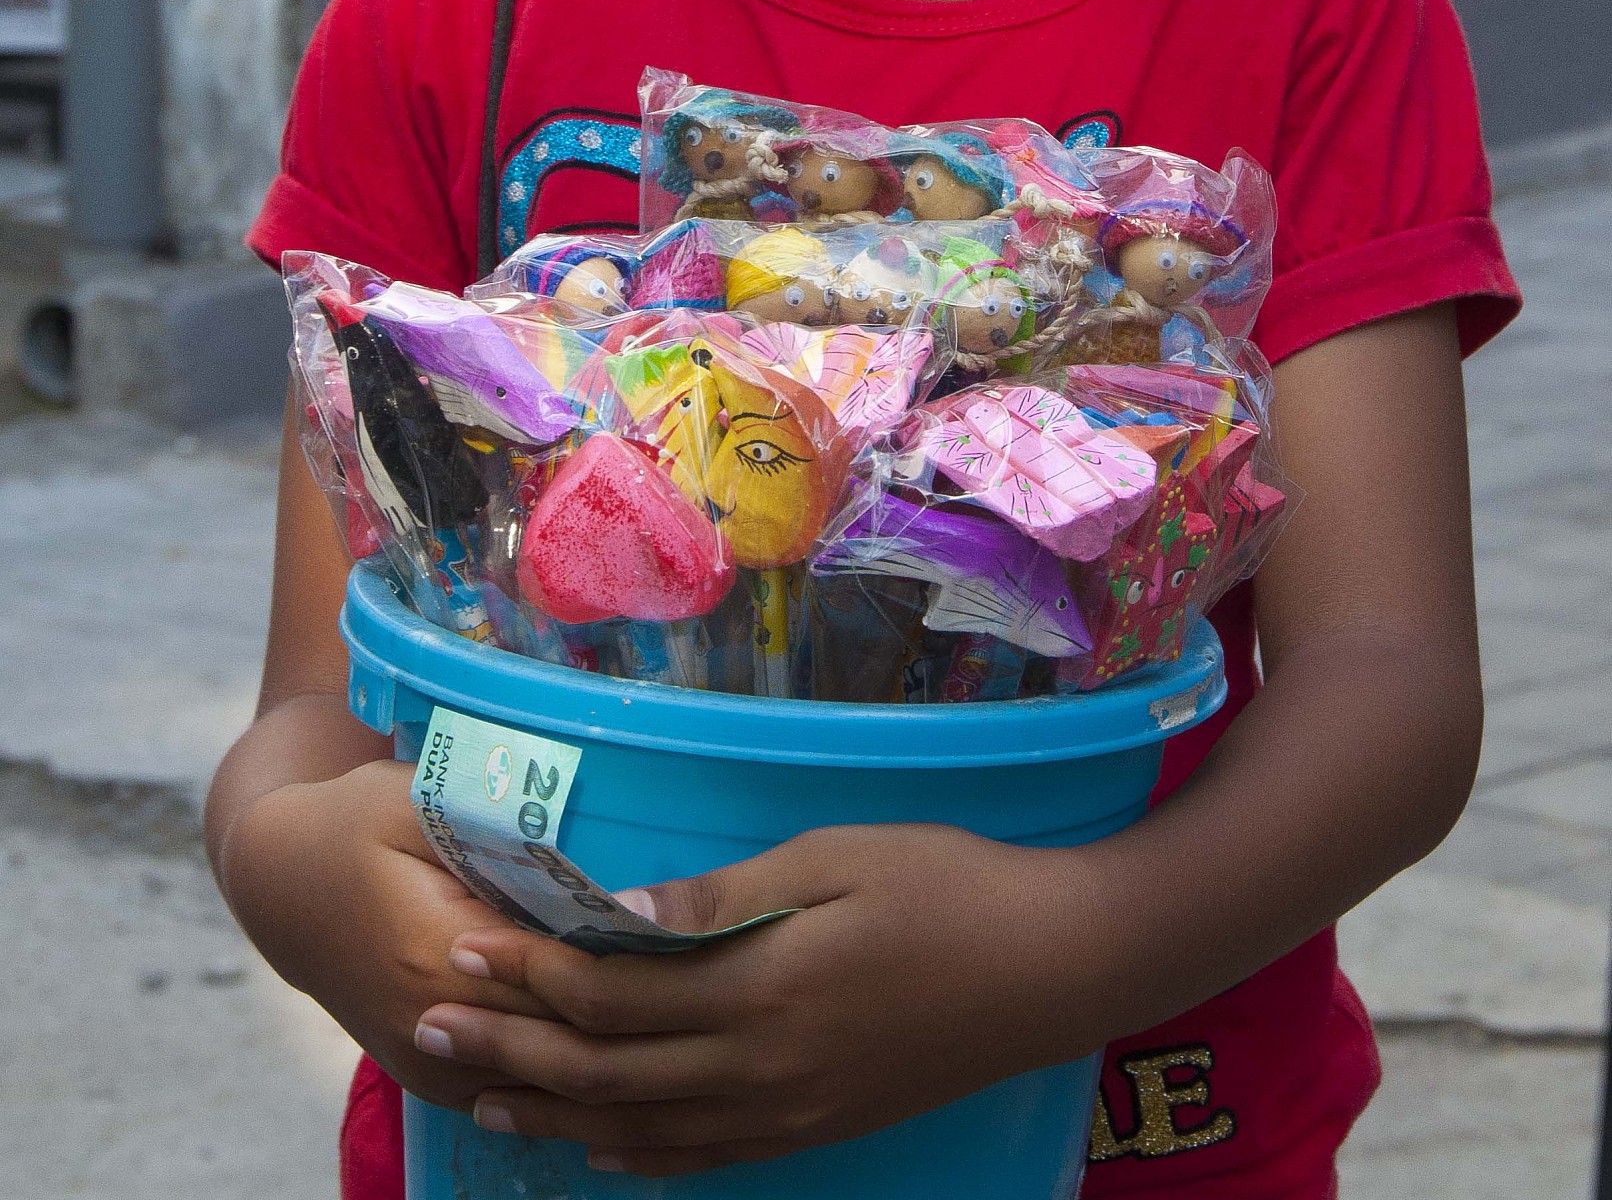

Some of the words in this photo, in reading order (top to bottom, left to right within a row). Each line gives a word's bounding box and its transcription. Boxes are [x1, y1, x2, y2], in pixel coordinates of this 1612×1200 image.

[422, 731, 443, 782] DUA
[433, 735, 454, 799] BANK
[518, 758, 617, 914] 20000
